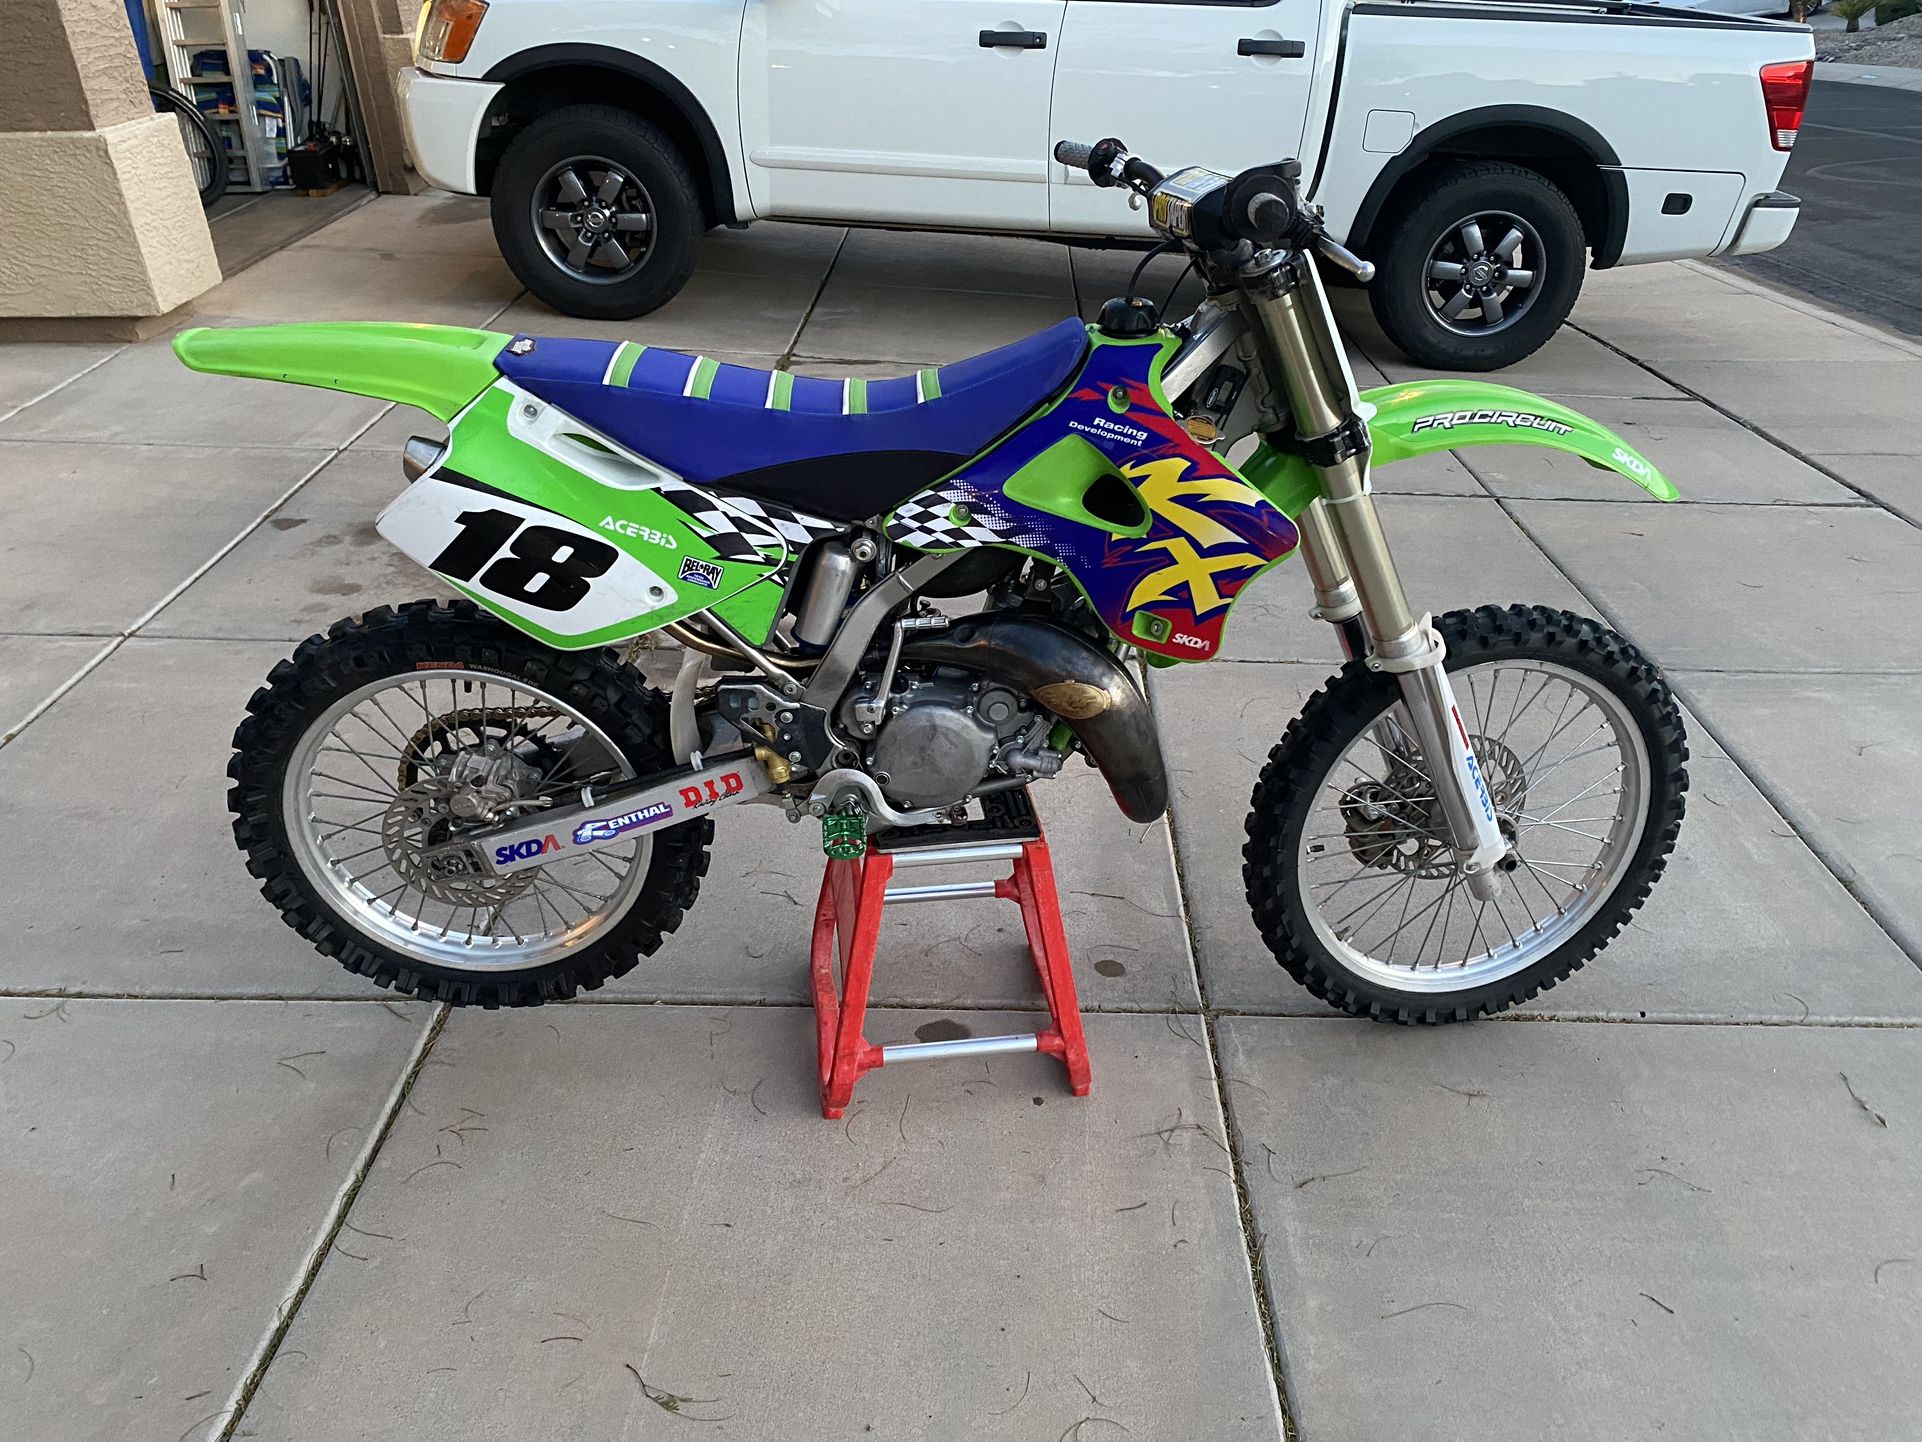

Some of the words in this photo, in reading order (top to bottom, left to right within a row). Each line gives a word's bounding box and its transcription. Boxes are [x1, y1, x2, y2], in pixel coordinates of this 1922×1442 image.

[1068, 420, 1143, 447] Development
[1093, 417, 1148, 440] Racing
[598, 515, 678, 550] ACERBIS
[428, 508, 619, 612] 18
[1172, 633, 1210, 651] SKDA
[469, 663, 521, 682] WASHOUGAL
[495, 834, 562, 865] SKDA
